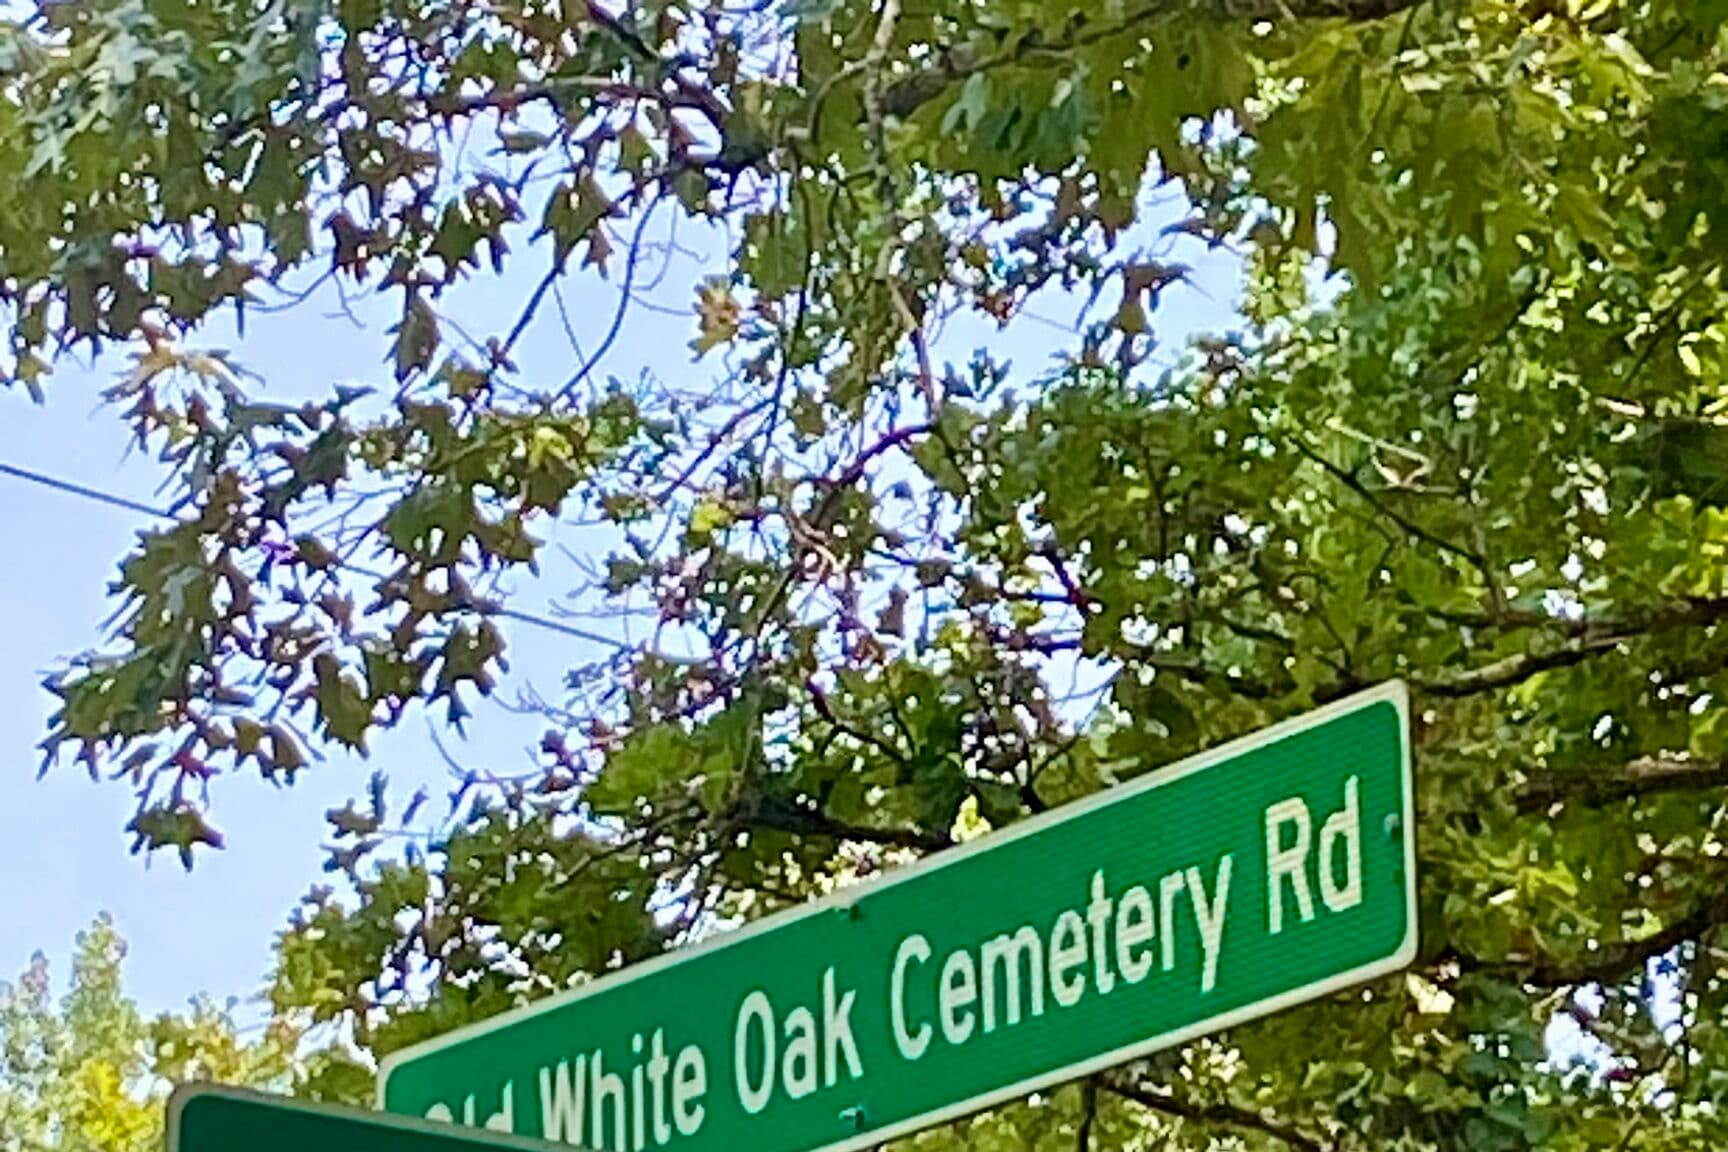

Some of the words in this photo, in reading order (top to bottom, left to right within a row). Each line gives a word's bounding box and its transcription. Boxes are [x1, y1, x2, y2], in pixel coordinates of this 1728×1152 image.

[538, 1027, 707, 1152] White
[734, 966, 864, 1114] Oak
[891, 853, 1234, 1060] Cemetery
[1264, 775, 1363, 936] Rd
